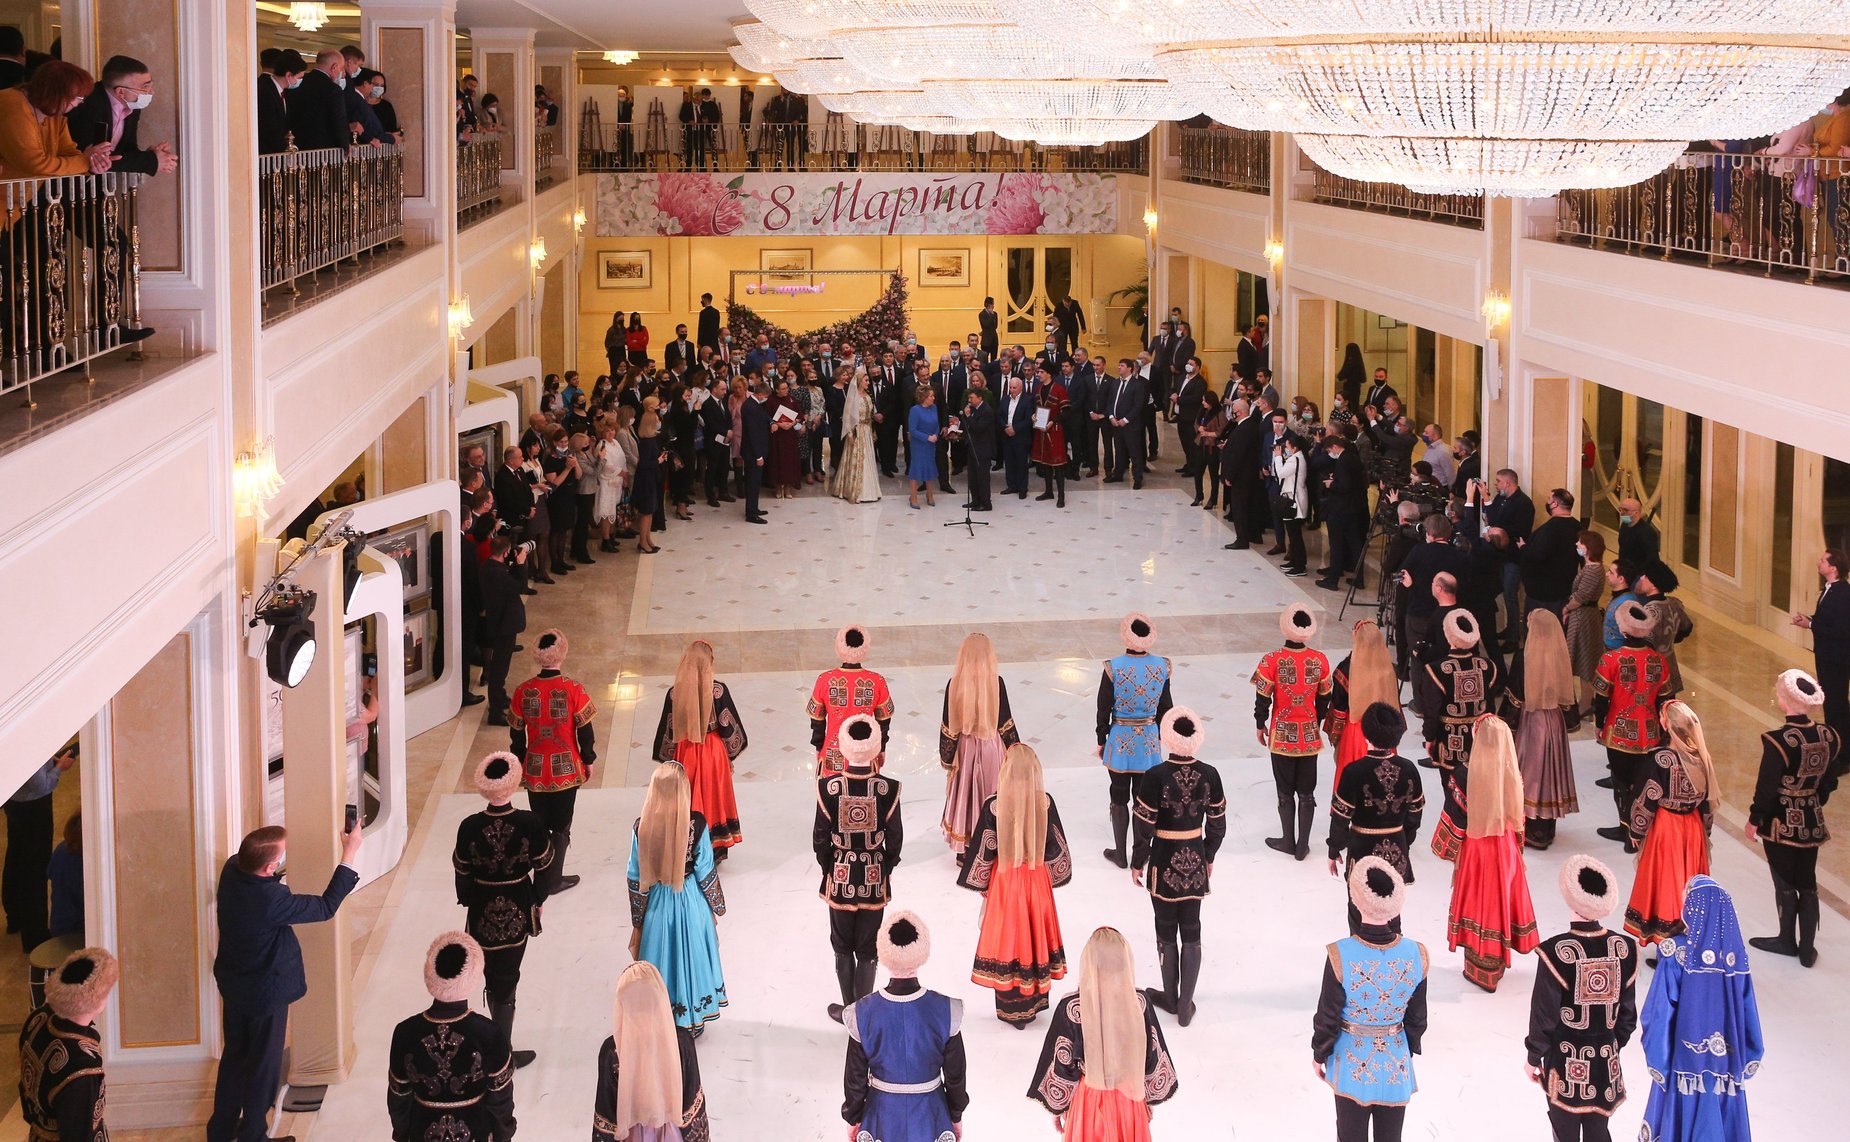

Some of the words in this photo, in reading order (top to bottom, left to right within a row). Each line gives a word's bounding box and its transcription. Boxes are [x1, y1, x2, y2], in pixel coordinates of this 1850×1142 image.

[712, 189, 741, 236] С
[763, 184, 795, 231] 8
[812, 173, 1005, 236] Марта!
